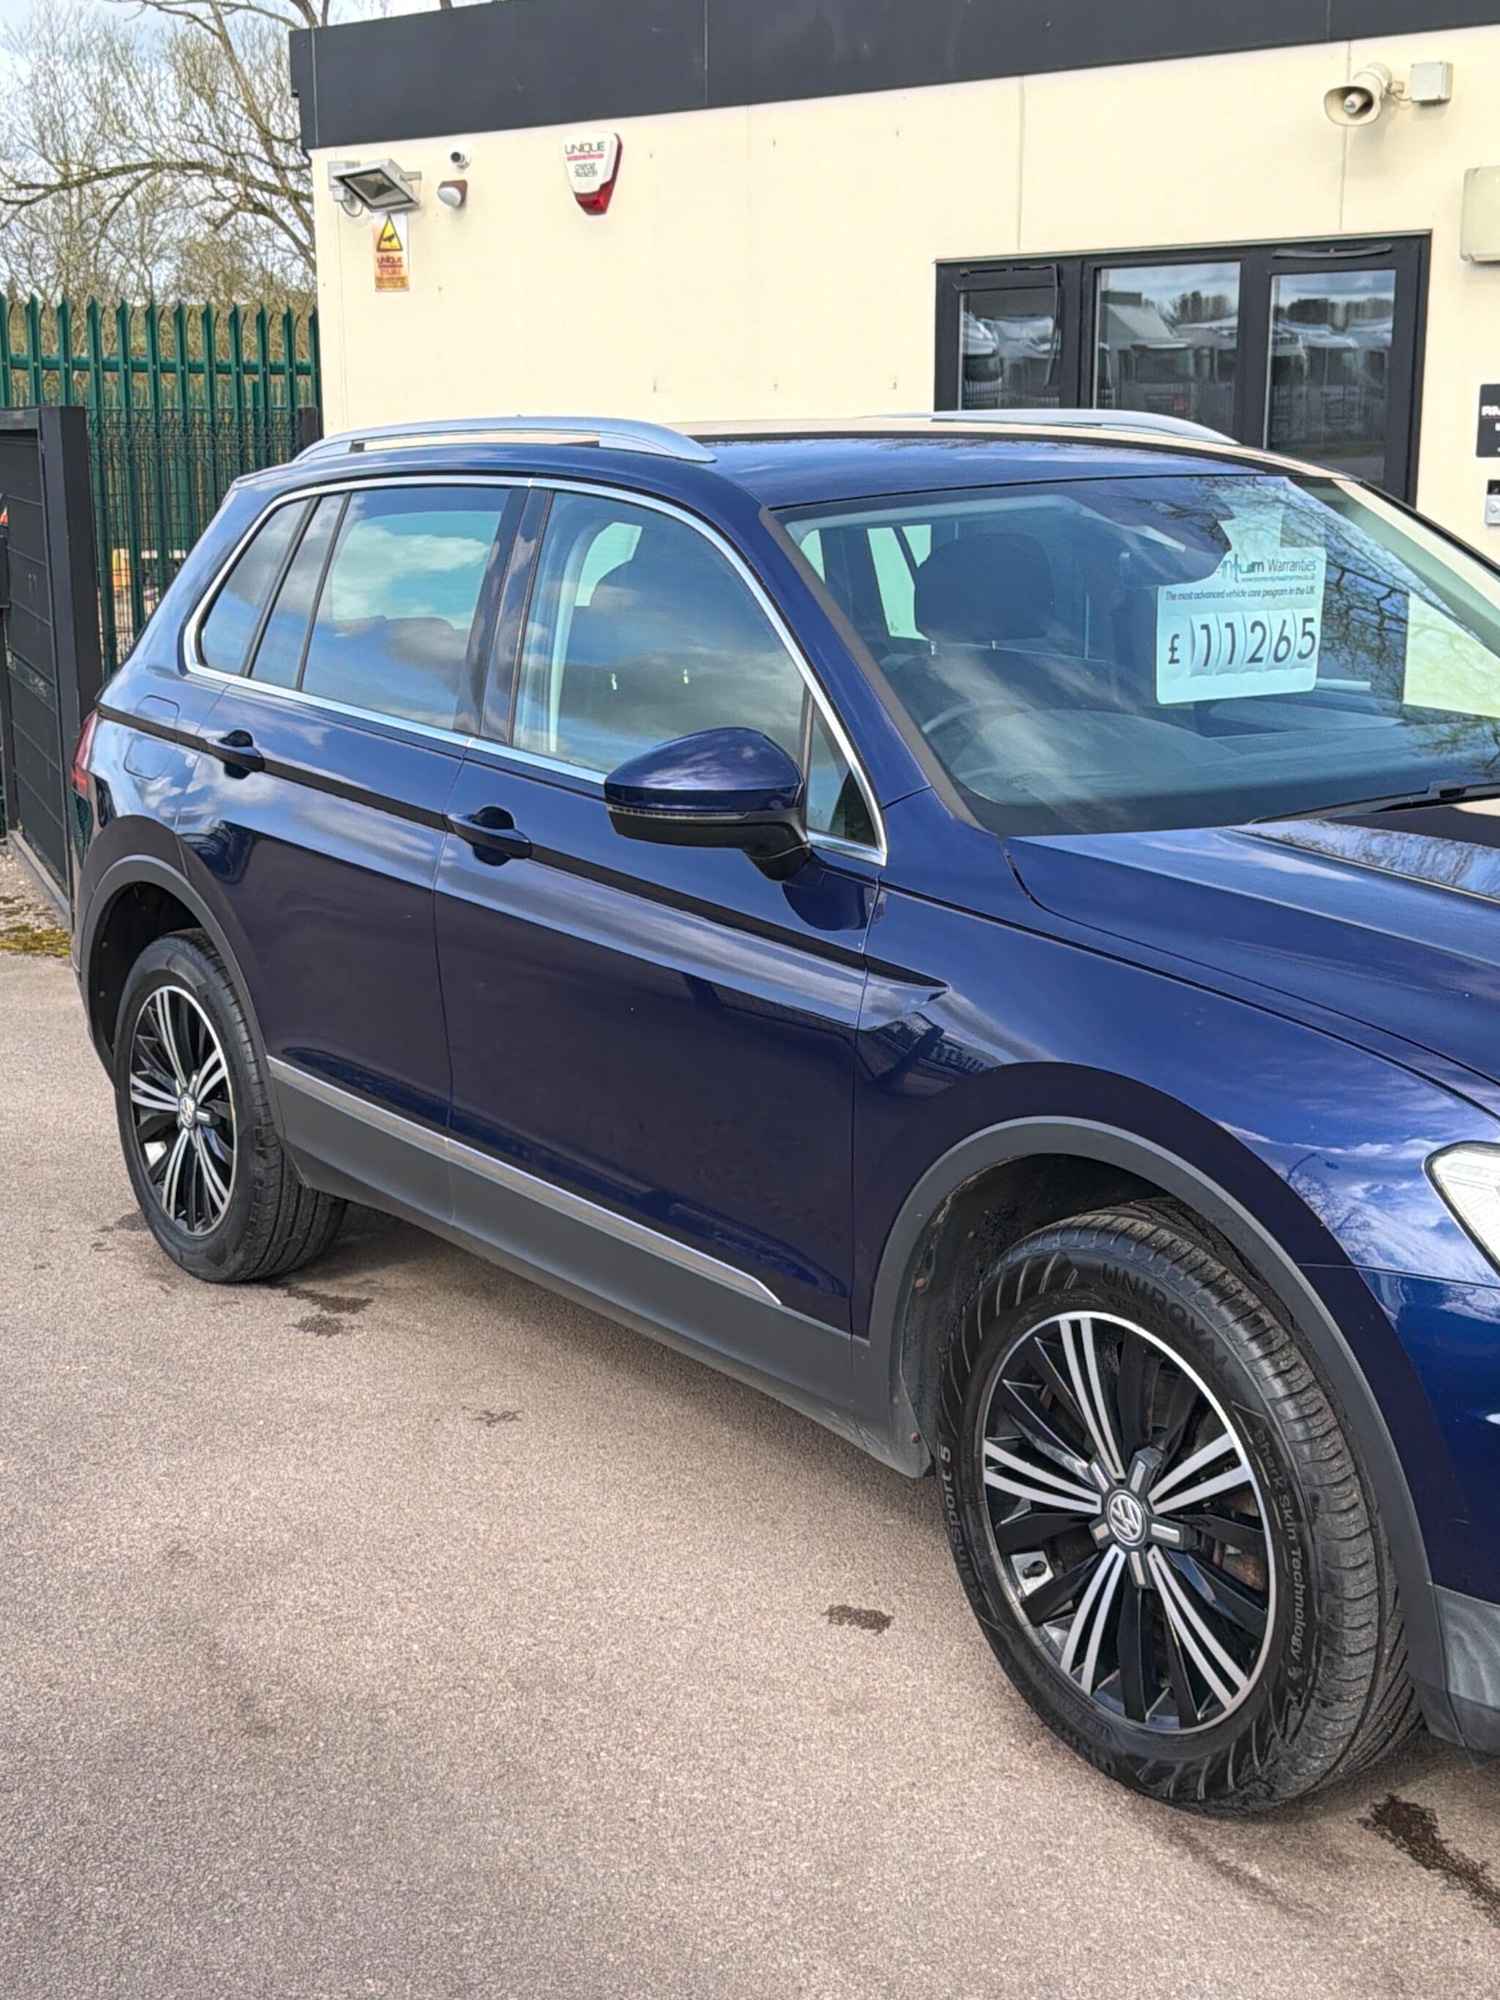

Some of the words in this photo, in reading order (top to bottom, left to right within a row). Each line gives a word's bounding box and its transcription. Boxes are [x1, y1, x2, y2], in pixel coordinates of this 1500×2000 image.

[1268, 557, 1317, 573] Warranties
[1166, 591, 1177, 601] The
[1178, 592, 1193, 600] most
[1194, 590, 1225, 600] advanced
[1226, 588, 1247, 599] vehicle
[1262, 588, 1288, 599] program
[1296, 586, 1305, 596] the
[1306, 585, 1315, 595] UK
[1278, 1494, 1297, 1541] Skin
[1289, 1545, 1307, 1663] Technology
